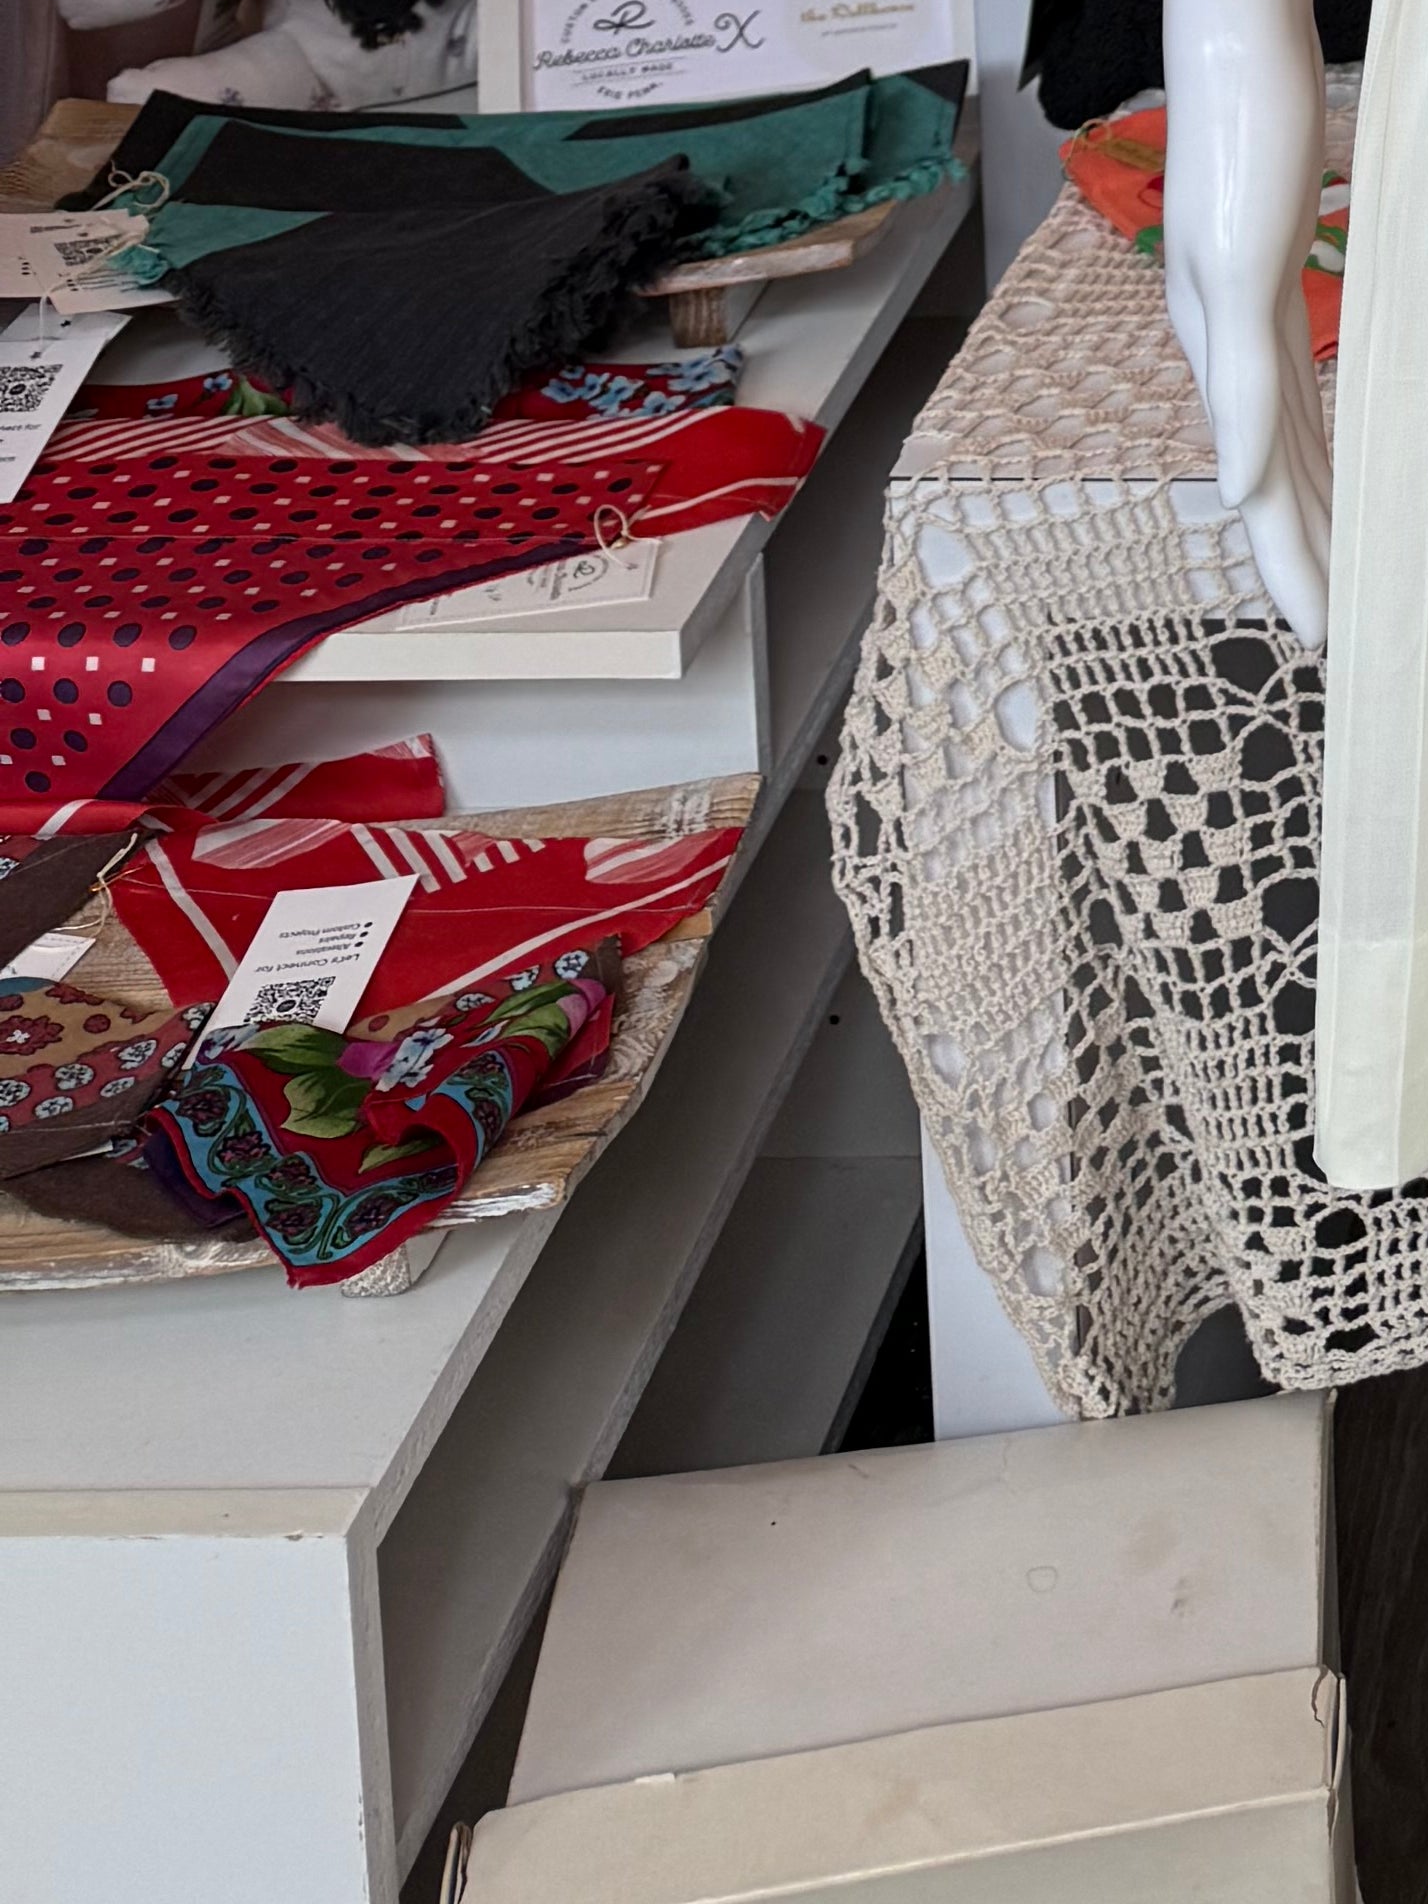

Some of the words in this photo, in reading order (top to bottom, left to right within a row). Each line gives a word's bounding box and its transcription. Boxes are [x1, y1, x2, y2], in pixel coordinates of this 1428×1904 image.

[532, 49, 622, 71] Rebecca
[625, 33, 718, 59] Charlotte
[278, 926, 321, 940] Projects
[295, 943, 352, 956] Alterations
[276, 957, 328, 972] Connect
[330, 952, 360, 965] Let's
